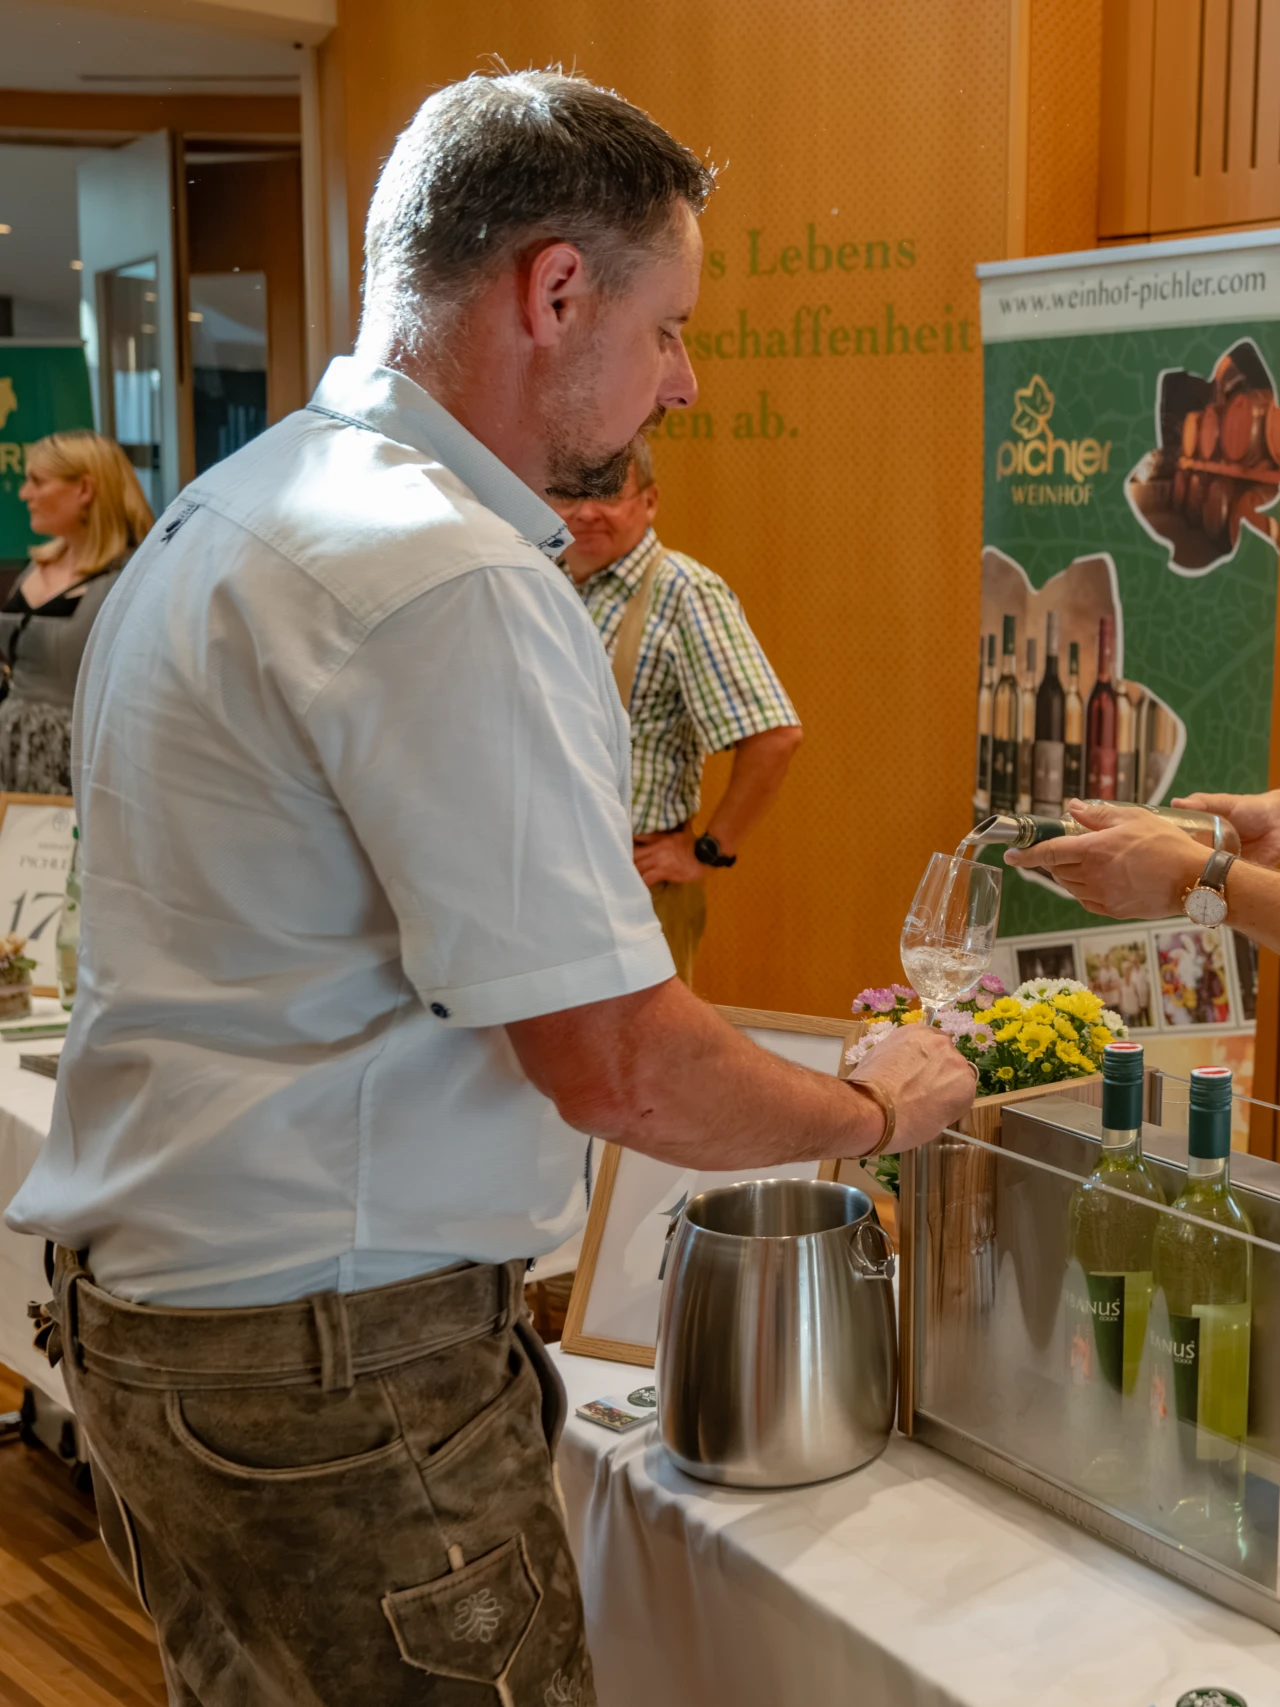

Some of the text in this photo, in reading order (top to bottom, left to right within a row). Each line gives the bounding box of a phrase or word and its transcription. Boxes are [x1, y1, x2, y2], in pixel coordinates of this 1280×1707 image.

[748, 222, 916, 277] Lebens
[999, 270, 1266, 315] www.weinhof-pichler.com
[732, 390, 798, 440] ab.
[996, 430, 1112, 482] pichler
[1011, 483, 1093, 506] WEINHOF
